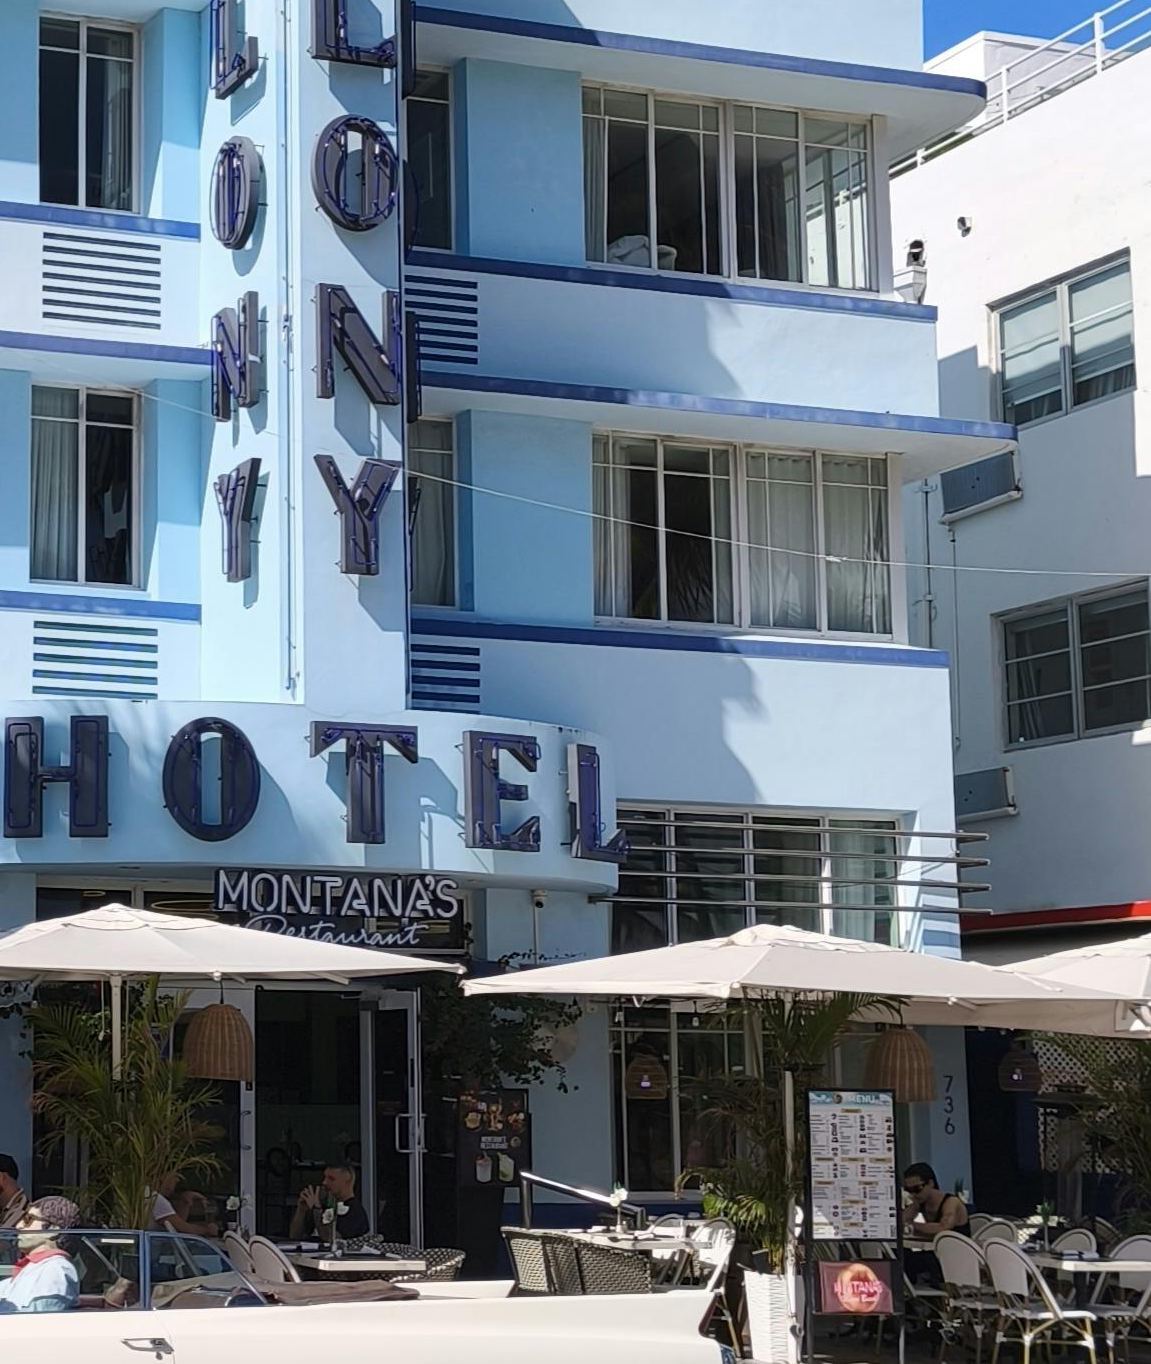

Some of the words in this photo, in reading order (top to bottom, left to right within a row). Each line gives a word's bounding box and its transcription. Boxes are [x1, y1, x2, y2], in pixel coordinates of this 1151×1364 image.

[3, 715, 630, 863] HOTEL
[217, 869, 459, 918] MONTANA'S
[943, 1075, 955, 1135] 736
